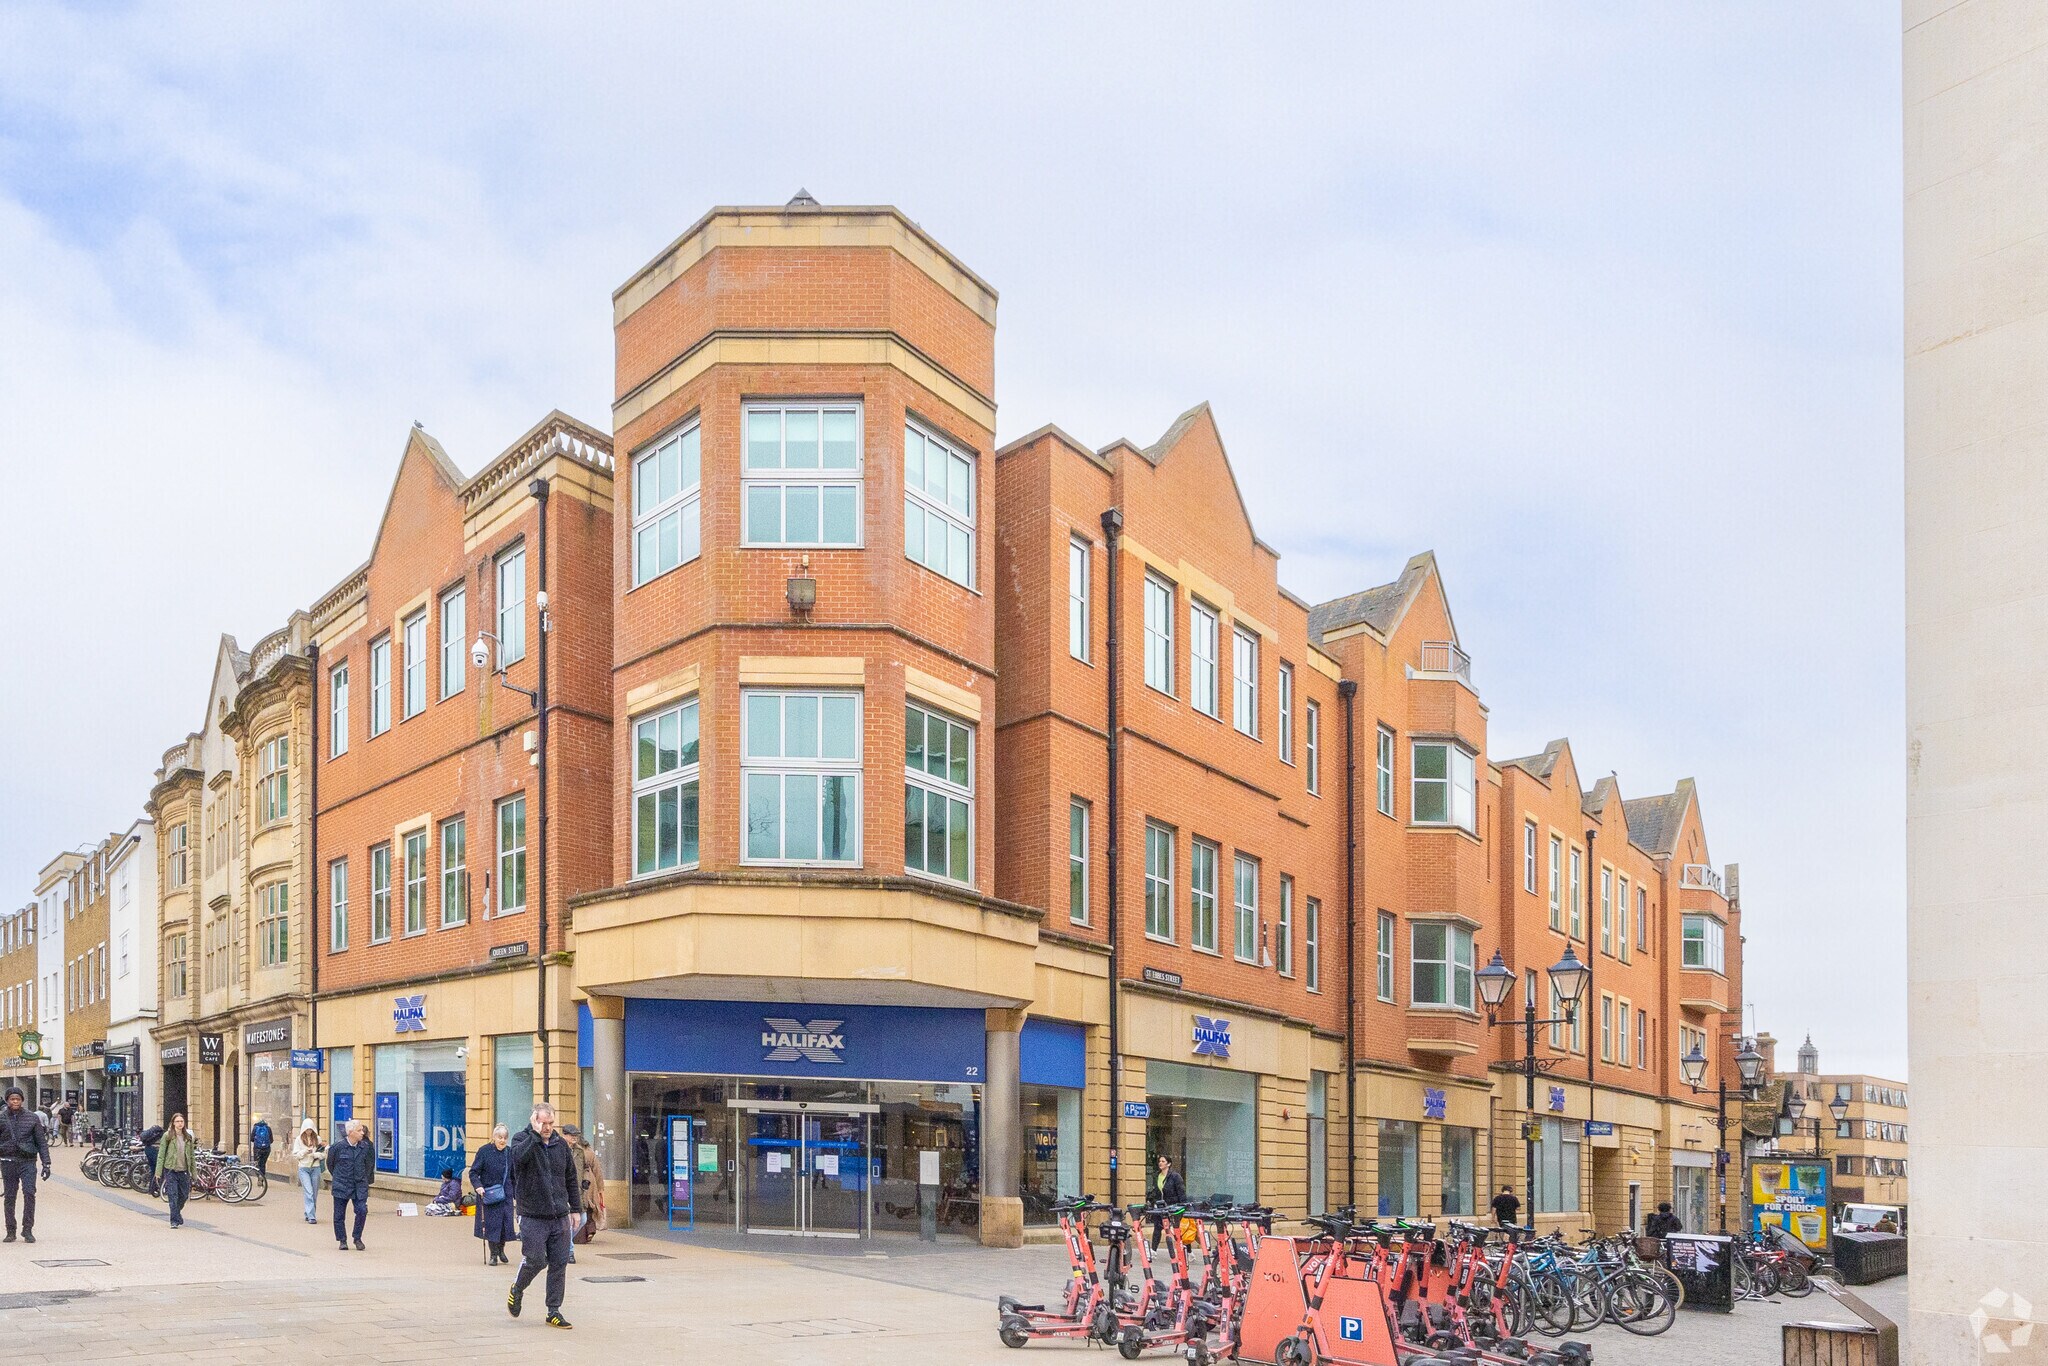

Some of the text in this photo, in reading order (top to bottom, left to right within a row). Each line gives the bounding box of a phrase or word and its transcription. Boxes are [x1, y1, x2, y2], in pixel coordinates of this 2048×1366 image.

[492, 944, 524, 956] QUEEN STREET
[1165, 973, 1180, 984] STREET
[393, 1007, 424, 1020] HALIFAX
[246, 1027, 284, 1045] WATERSTONES
[762, 1032, 845, 1049] HALIFAX
[1194, 1028, 1231, 1045] HALIFAX
[202, 1036, 221, 1050] W
[966, 1067, 978, 1076] 22
[1425, 1097, 1446, 1108] HALIFAX
[1775, 1195, 1806, 1203] SPOILT
[1764, 1203, 1817, 1212] FOR CHOICE
[1345, 1319, 1359, 1338] P
